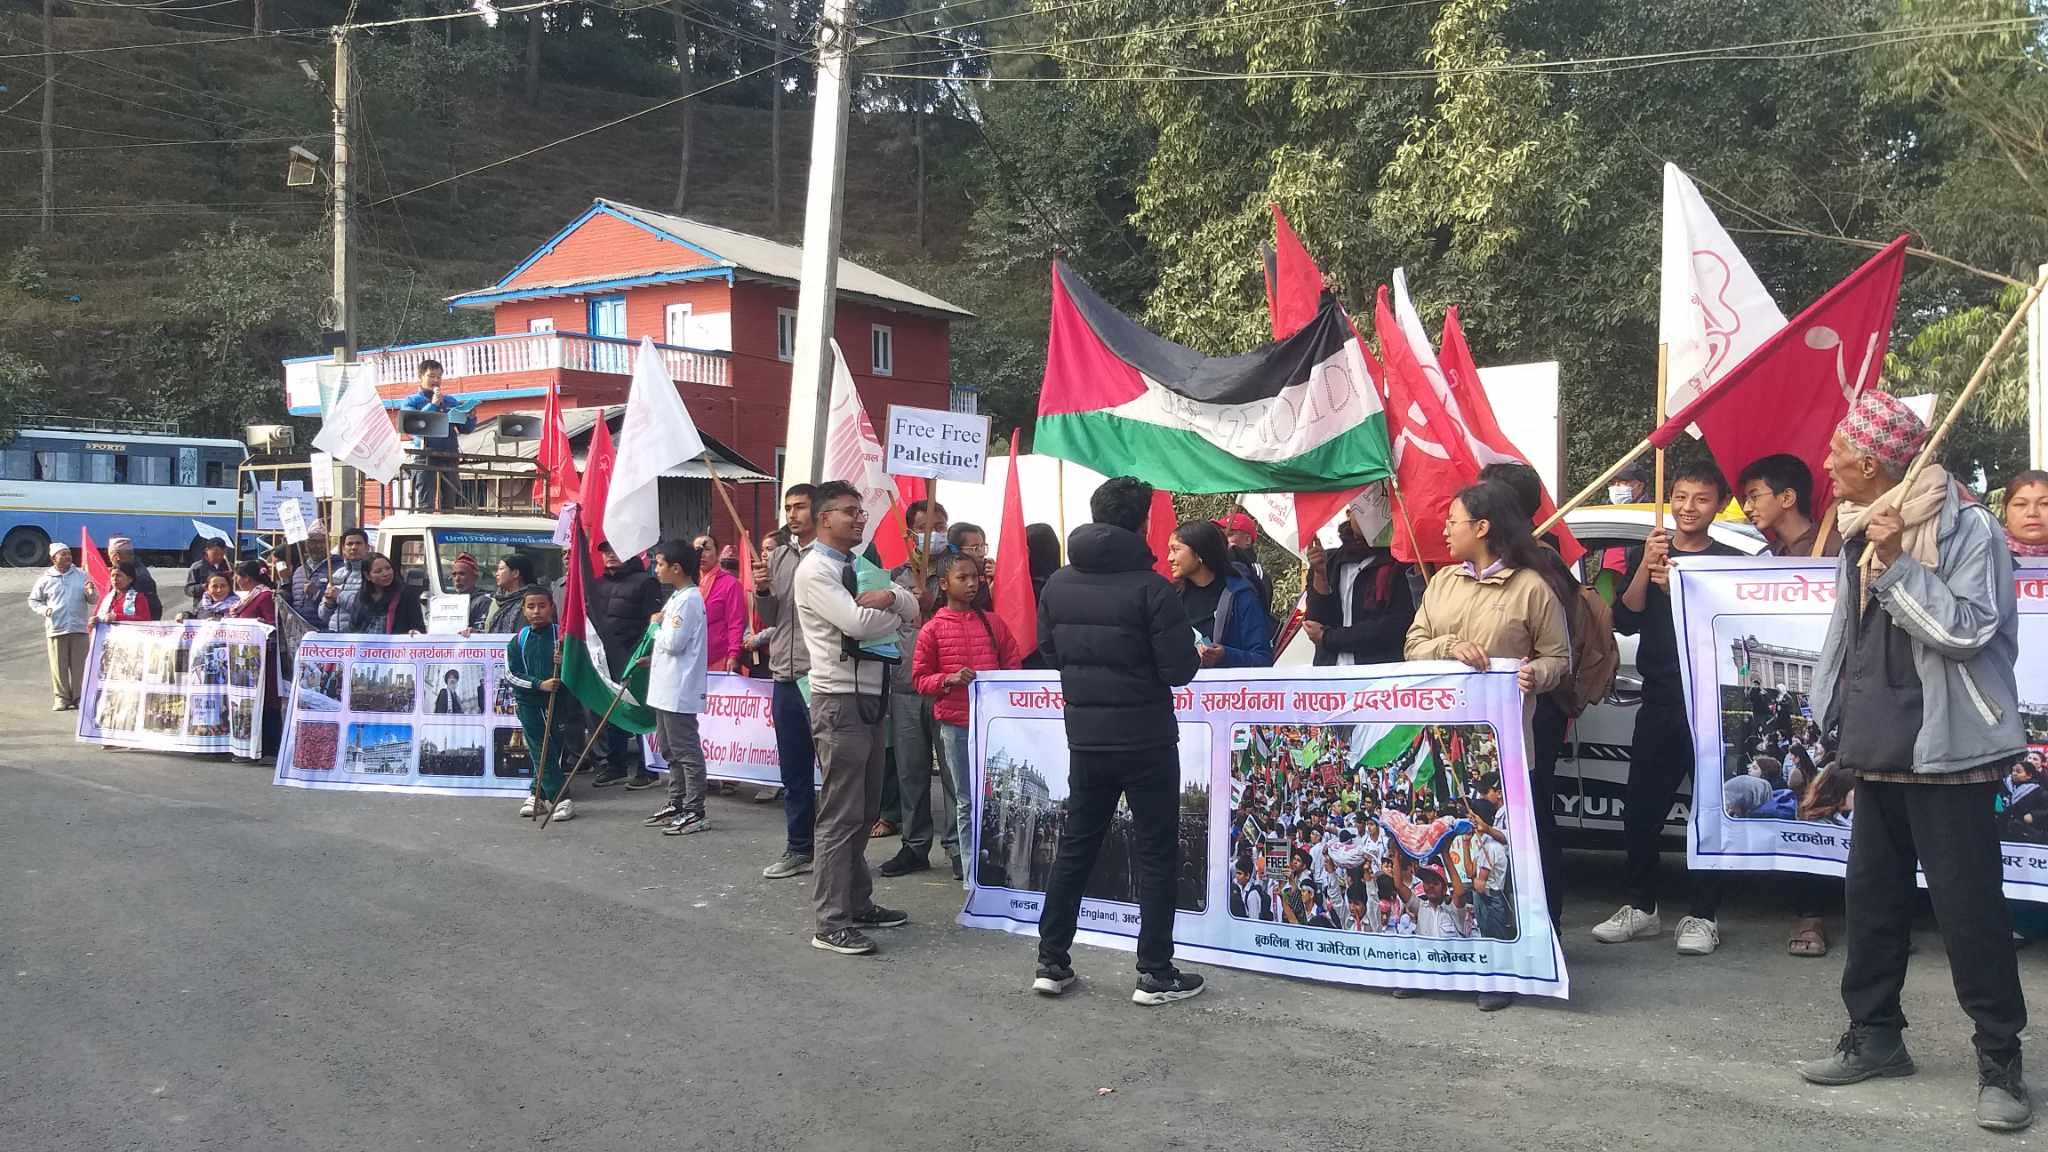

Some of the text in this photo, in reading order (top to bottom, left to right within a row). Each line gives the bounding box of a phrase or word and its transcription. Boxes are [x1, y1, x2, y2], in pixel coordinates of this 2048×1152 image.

[895, 418, 981, 444] Free Free
[893, 443, 979, 469] Palestine!
[1201, 687, 1285, 712] समर्थनमा
[1292, 691, 1346, 712] भएका
[702, 739, 727, 765] Stop
[729, 739, 748, 764] War
[1265, 855, 1288, 870] FREE
